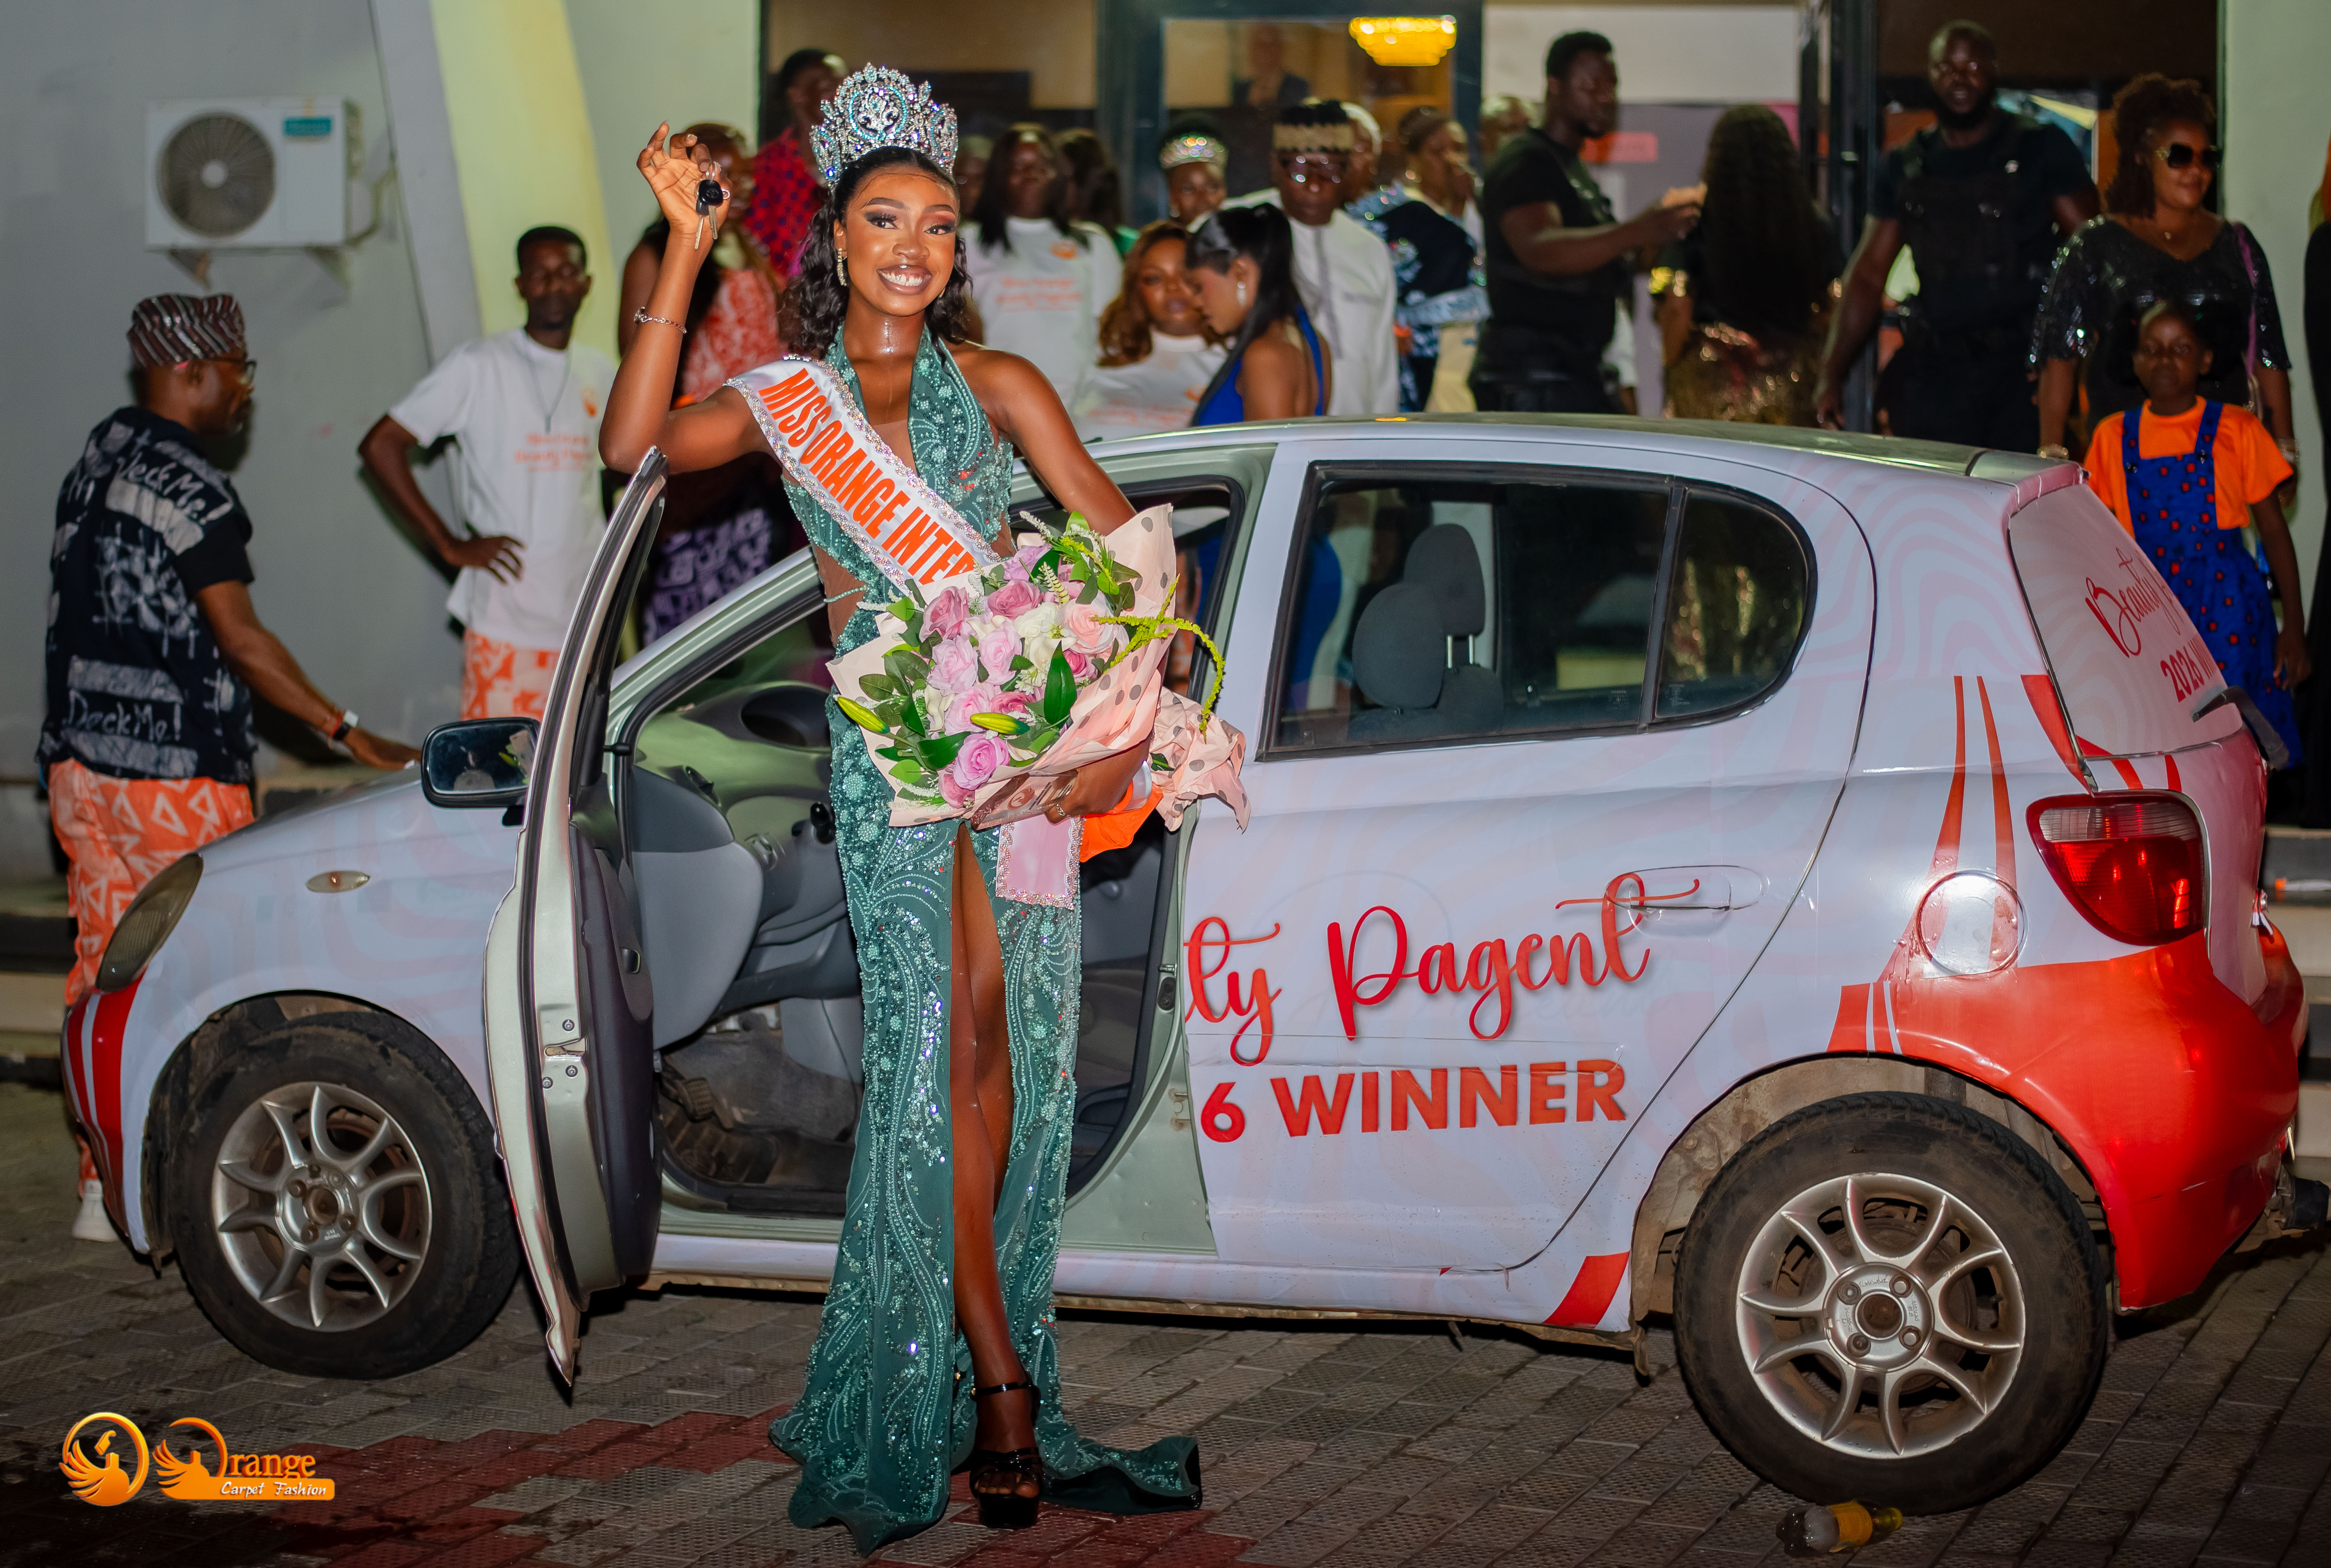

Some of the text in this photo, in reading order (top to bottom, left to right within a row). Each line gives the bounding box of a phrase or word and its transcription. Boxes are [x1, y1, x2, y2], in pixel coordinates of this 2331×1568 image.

[758, 368, 833, 448] MISS
[800, 420, 910, 539] ORANGE
[2085, 546, 2181, 659] Beauty
[2160, 646, 2205, 703] 2026
[1327, 872, 1700, 1041] Pagent
[1200, 1060, 1626, 1143] 6 WINNER
